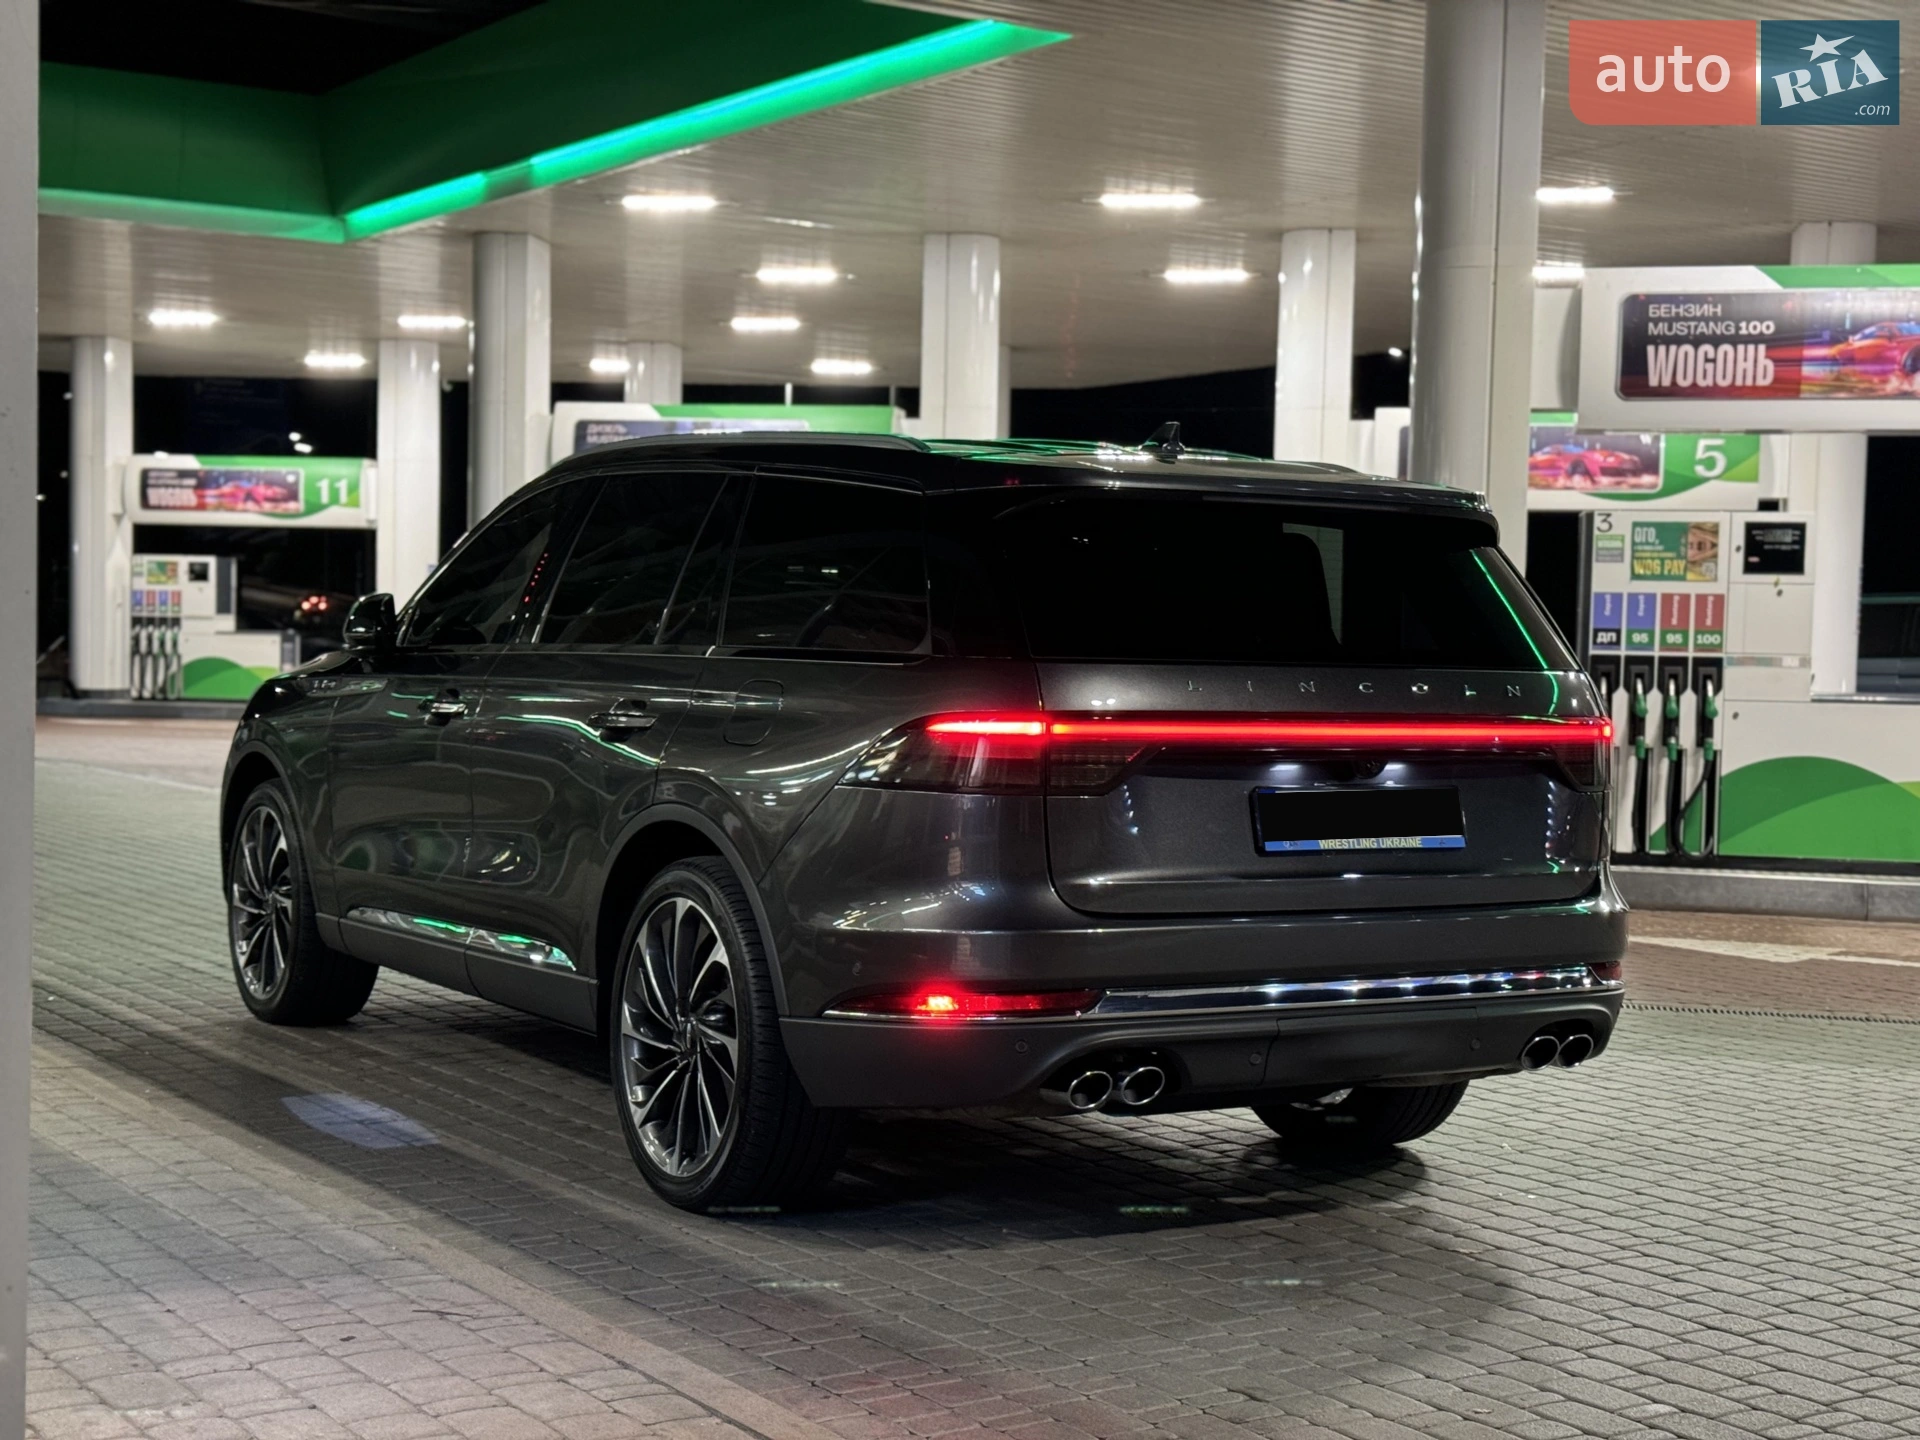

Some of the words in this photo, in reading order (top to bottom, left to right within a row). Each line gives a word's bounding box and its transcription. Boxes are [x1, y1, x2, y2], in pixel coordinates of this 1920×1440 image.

[1648, 303, 1722, 318] БЕНЗИН
[1647, 321, 1735, 336] MUSTANG
[1738, 320, 1776, 335] 100
[1694, 438, 1727, 478] 5
[316, 478, 348, 505] 11
[1596, 512, 1613, 533] 3
[1633, 559, 1661, 576] WOG
[1663, 559, 1686, 576] PAY
[1596, 631, 1617, 644] ДП
[1631, 633, 1649, 644] 95
[1666, 633, 1683, 644] 95
[1696, 634, 1721, 645] 100
[1187, 679, 1522, 698] LINCOLN
[1319, 838, 1377, 850] WRESTLING
[1379, 837, 1423, 848] UKRAINE
